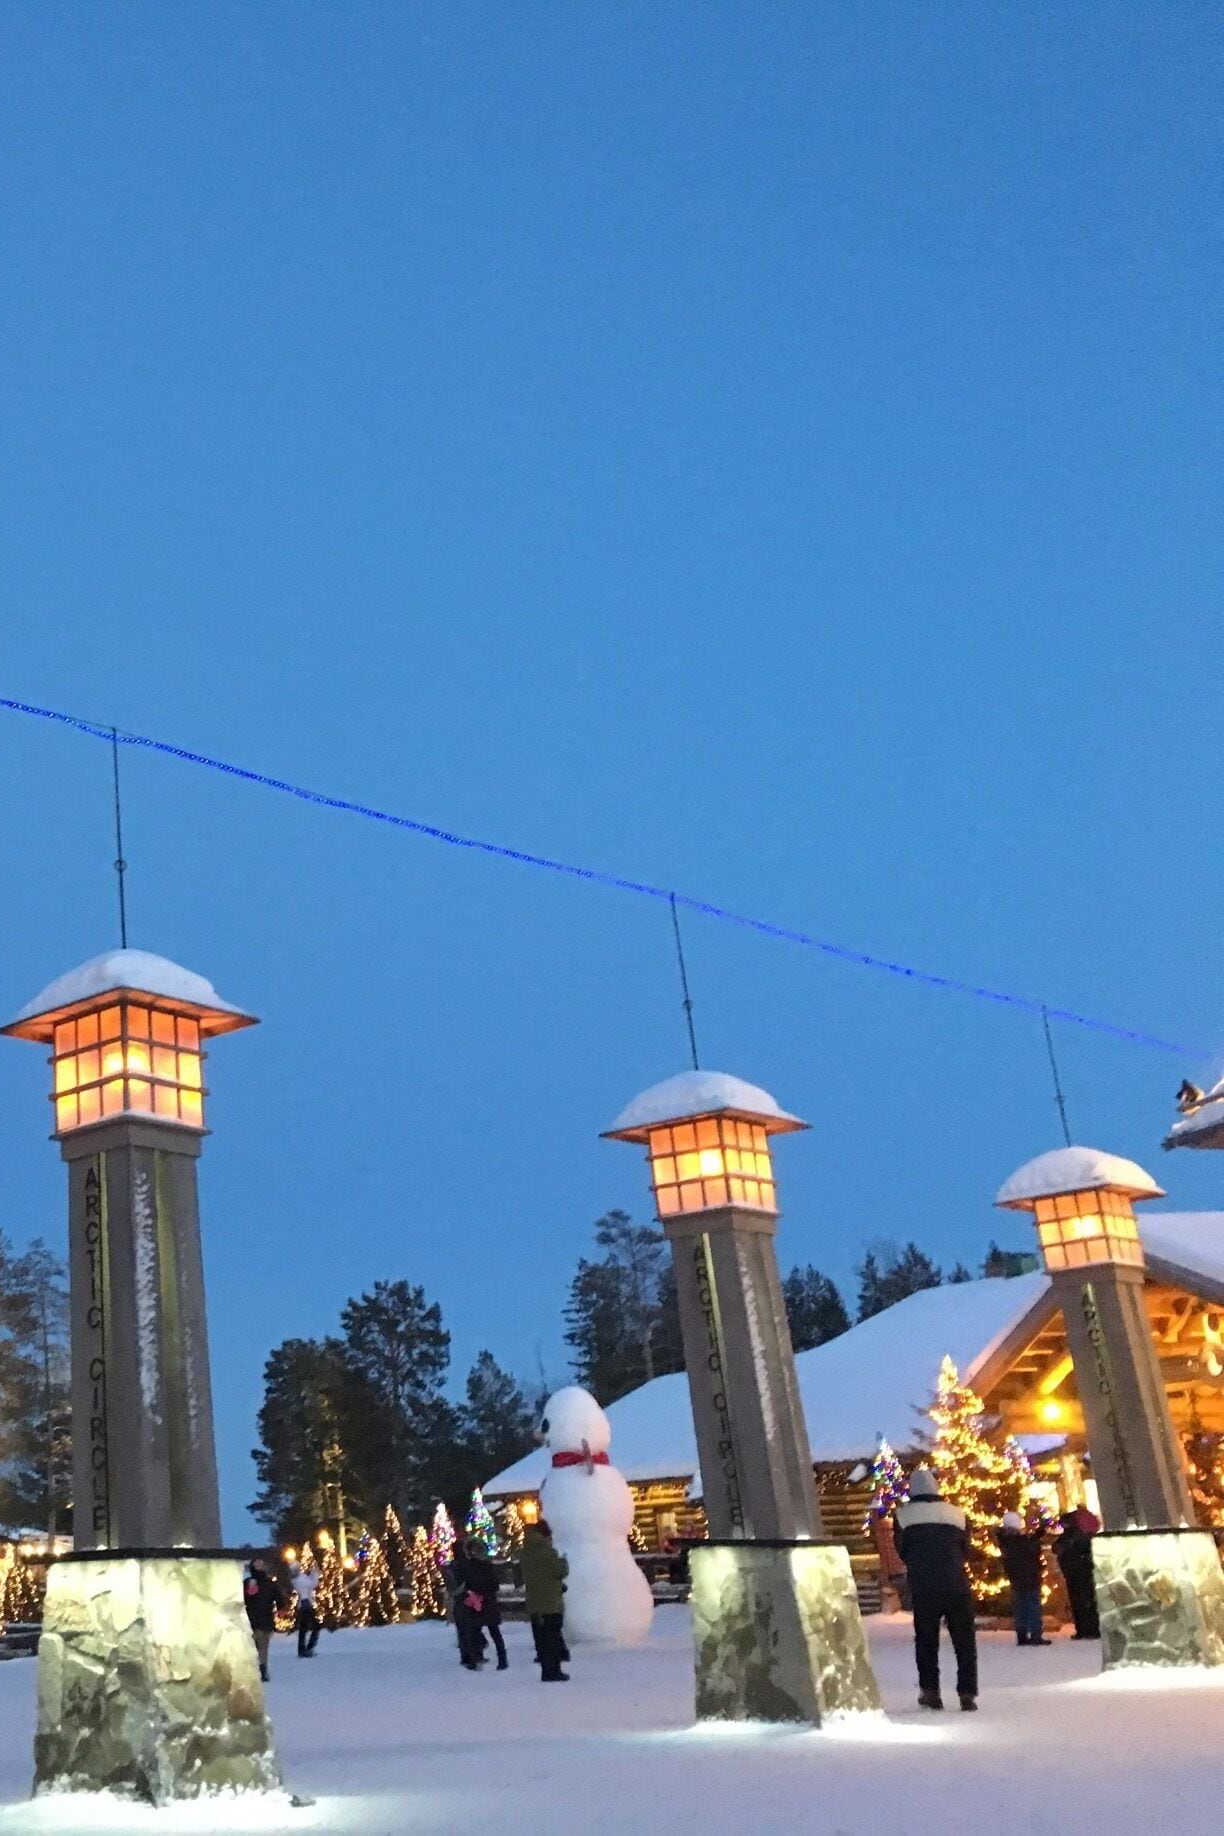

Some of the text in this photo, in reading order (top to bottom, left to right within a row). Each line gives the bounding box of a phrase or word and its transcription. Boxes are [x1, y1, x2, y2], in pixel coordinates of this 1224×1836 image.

[84, 1167, 107, 1532] ARCTIC CIRCLE
[693, 1245, 721, 1372] ARCTIC
